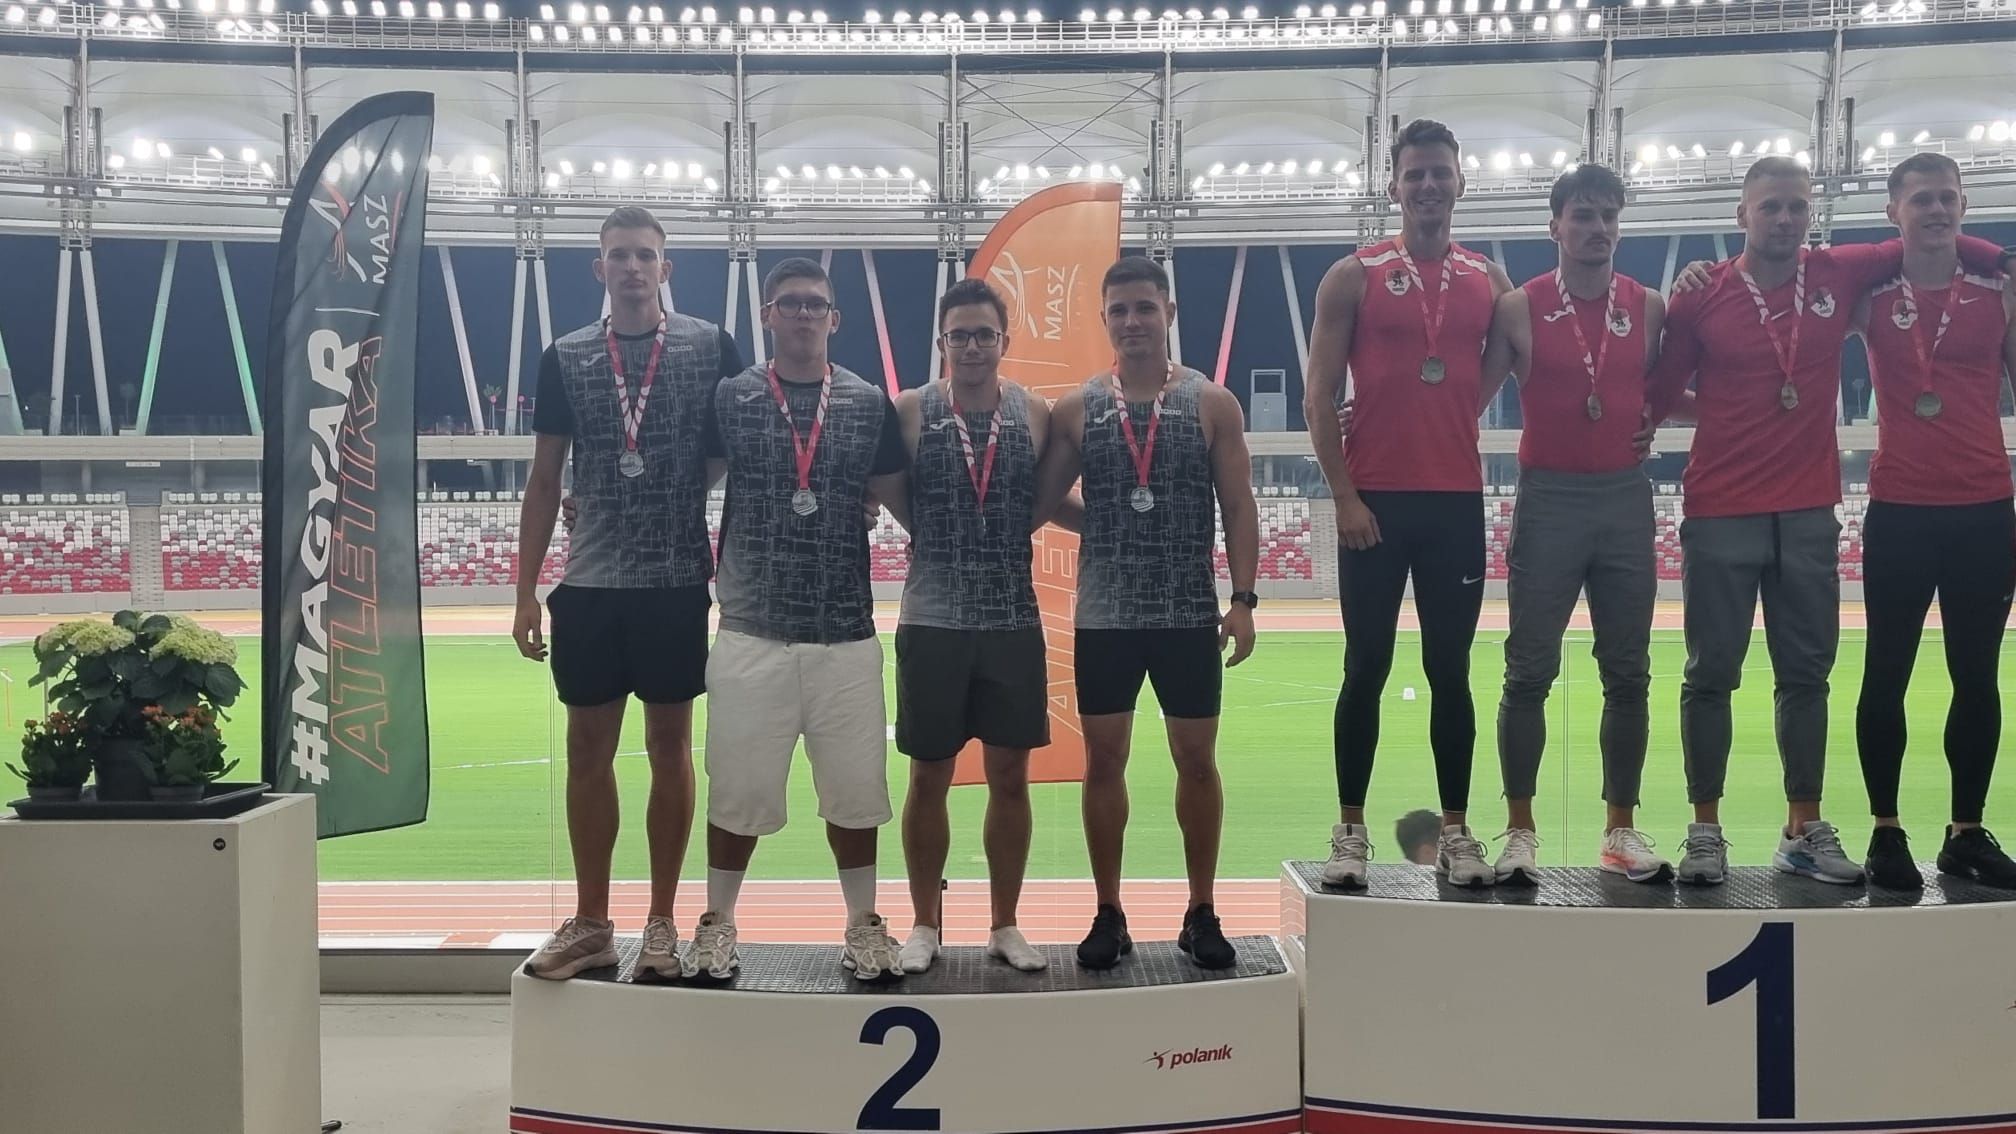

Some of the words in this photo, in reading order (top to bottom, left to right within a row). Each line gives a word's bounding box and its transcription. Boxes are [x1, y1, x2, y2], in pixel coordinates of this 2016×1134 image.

[363, 194, 390, 284] MASZ
[1043, 265, 1066, 341] MASZ
[291, 328, 360, 785] #MAGYAR
[330, 336, 390, 775] ATLETIKA
[856, 1005, 942, 1131] 2
[1169, 1043, 1233, 1070] polanik
[1706, 921, 1796, 1120] 1
